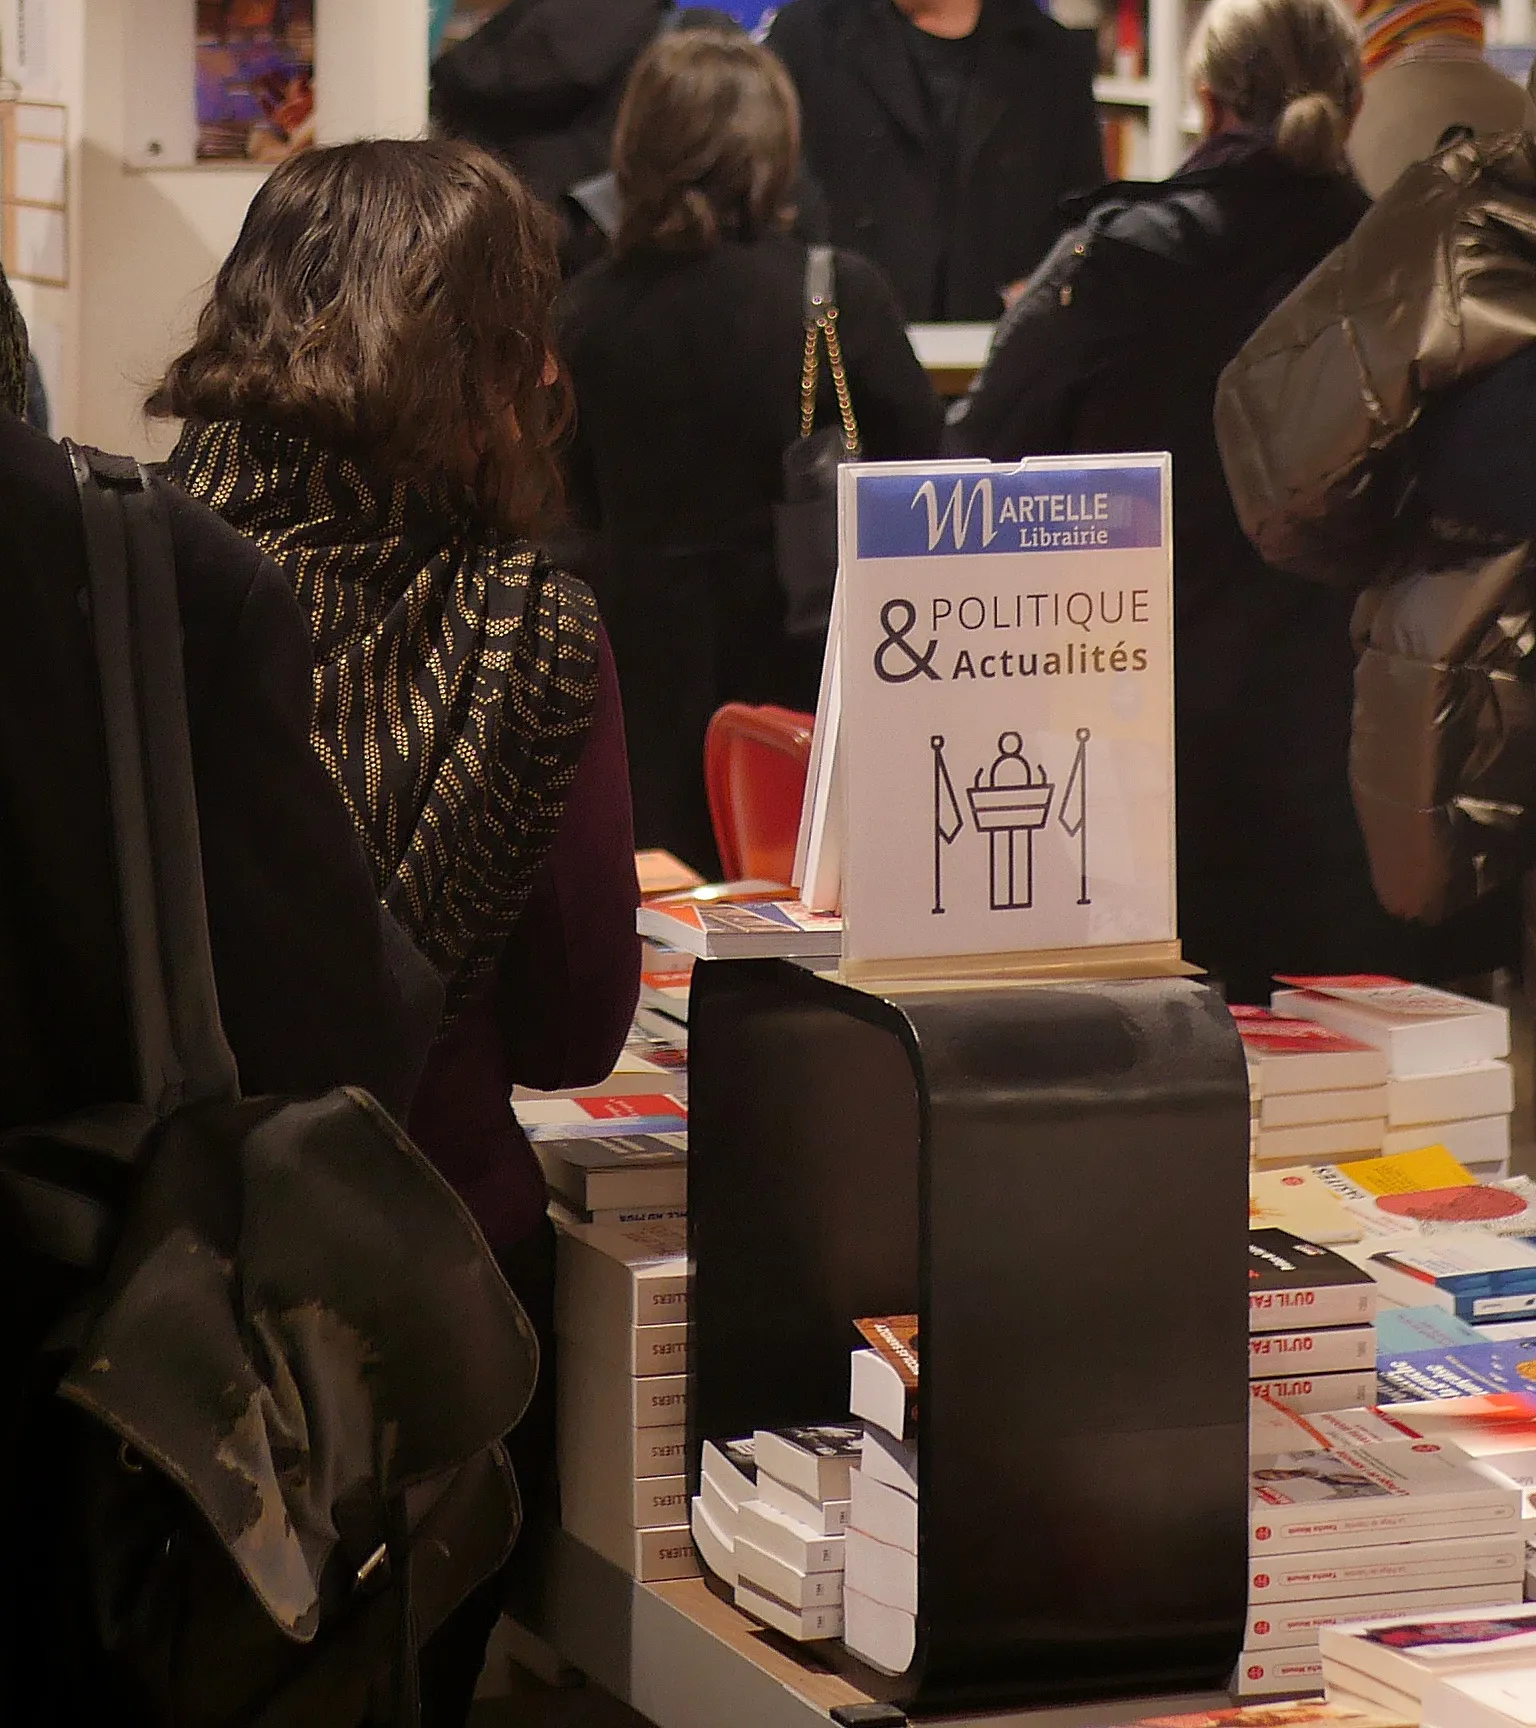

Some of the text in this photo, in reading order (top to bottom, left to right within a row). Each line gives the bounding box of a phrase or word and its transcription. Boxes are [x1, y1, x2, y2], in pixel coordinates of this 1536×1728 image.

[910, 477, 1109, 551] MARTELLE
[1019, 526, 1109, 548] Librairie
[873, 588, 1151, 684] & POLITIQUE
[952, 640, 1149, 681] Actualités
[1249, 1291, 1315, 1309] QU'IL FA
[1250, 1337, 1314, 1354] QU'IL FA
[1251, 1380, 1313, 1398] QU'IL FA
